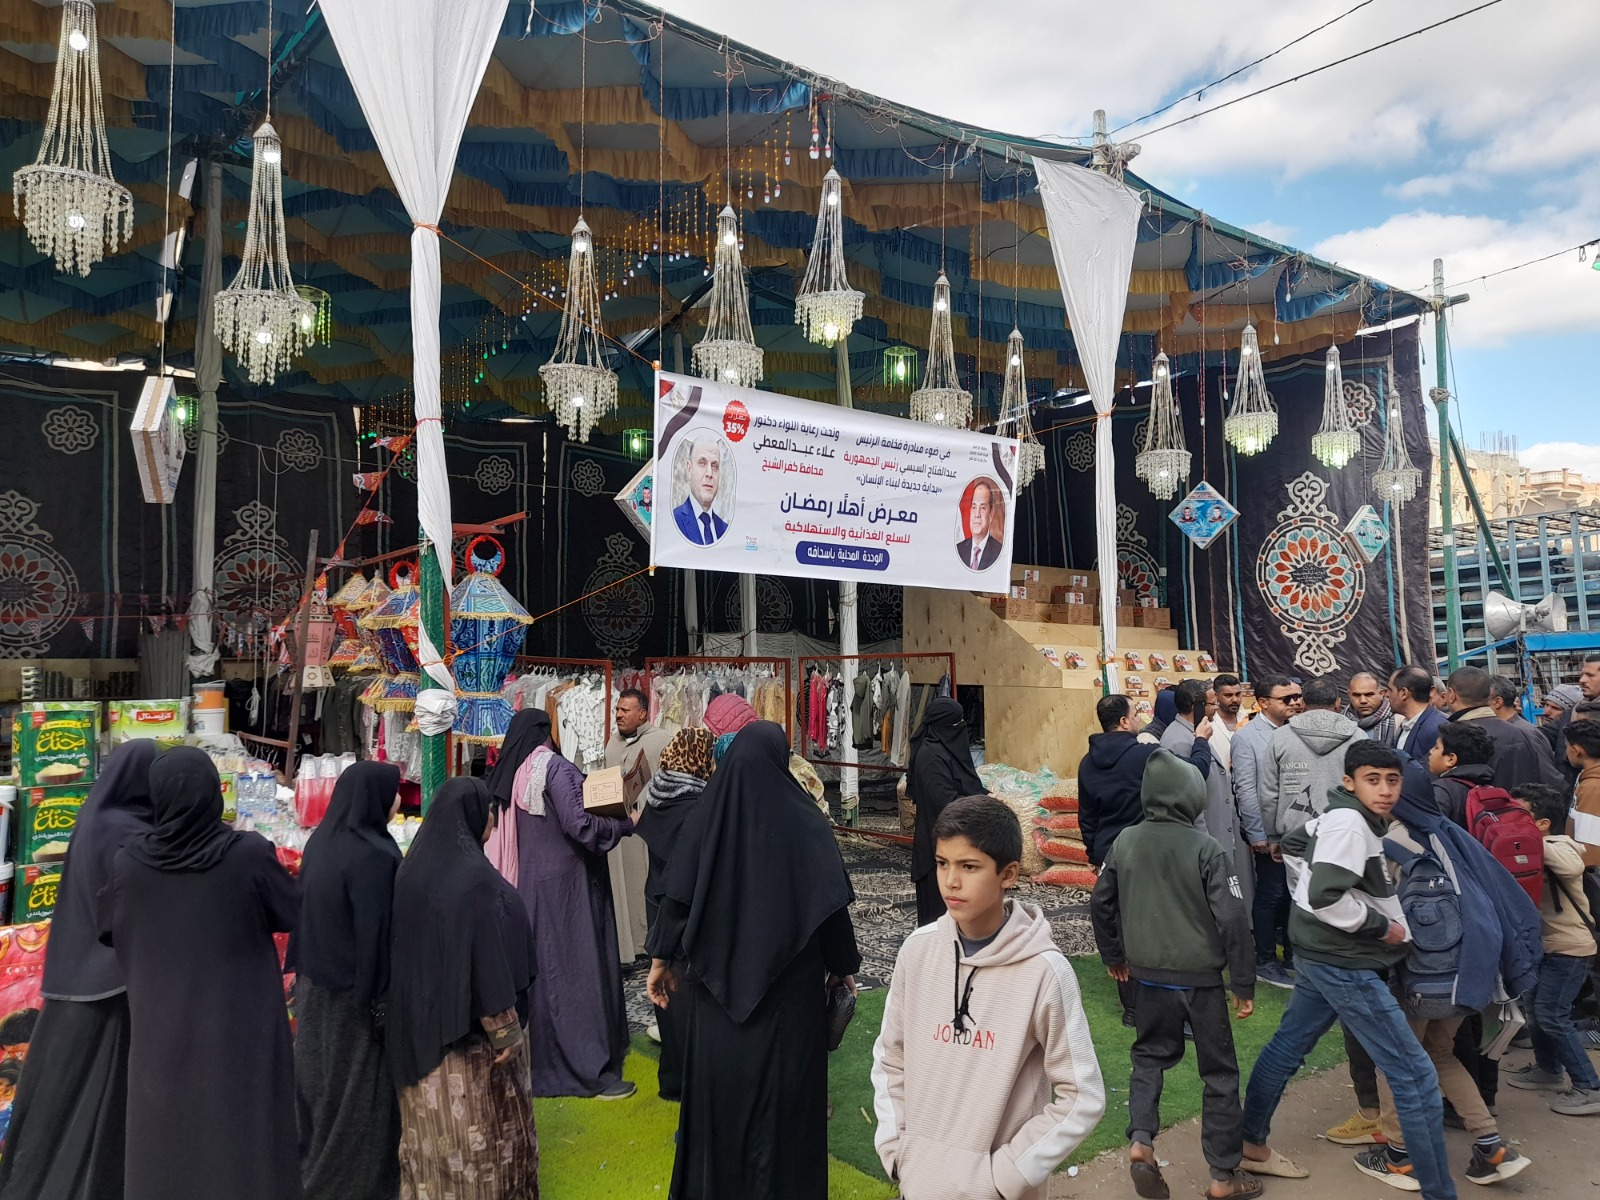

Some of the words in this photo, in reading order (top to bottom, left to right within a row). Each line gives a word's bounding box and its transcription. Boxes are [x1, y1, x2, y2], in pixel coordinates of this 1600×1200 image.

[726, 421, 745, 435] 35%
[754, 415, 776, 428] دكتور
[778, 418, 799, 433] اللواء
[800, 423, 819, 439] رعاية
[820, 427, 840, 442] وتحت
[856, 433, 880, 448] الرئيس
[881, 437, 902, 450] فخامة
[903, 440, 924, 455] مبادرة
[816, 443, 835, 458] علاء
[924, 446, 939, 458] ضوء
[939, 449, 951, 462] في
[843, 451, 880, 468] الجمهورية
[881, 457, 899, 472] رئيس
[899, 462, 926, 475] السيسي
[885, 477, 900, 490] لبناء
[901, 478, 921, 492] جديدة
[780, 492, 833, 519] رمضان
[868, 503, 918, 525] معرض
[784, 520, 847, 540] والاستهلاكية
[848, 527, 884, 541] الغذائية
[885, 533, 910, 546] للسلع
[837, 547, 860, 563] المحلية
[862, 550, 884, 566] الوحدة
[138, 712, 173, 721] كريستال
[933, 1024, 996, 1050] JORDAN
